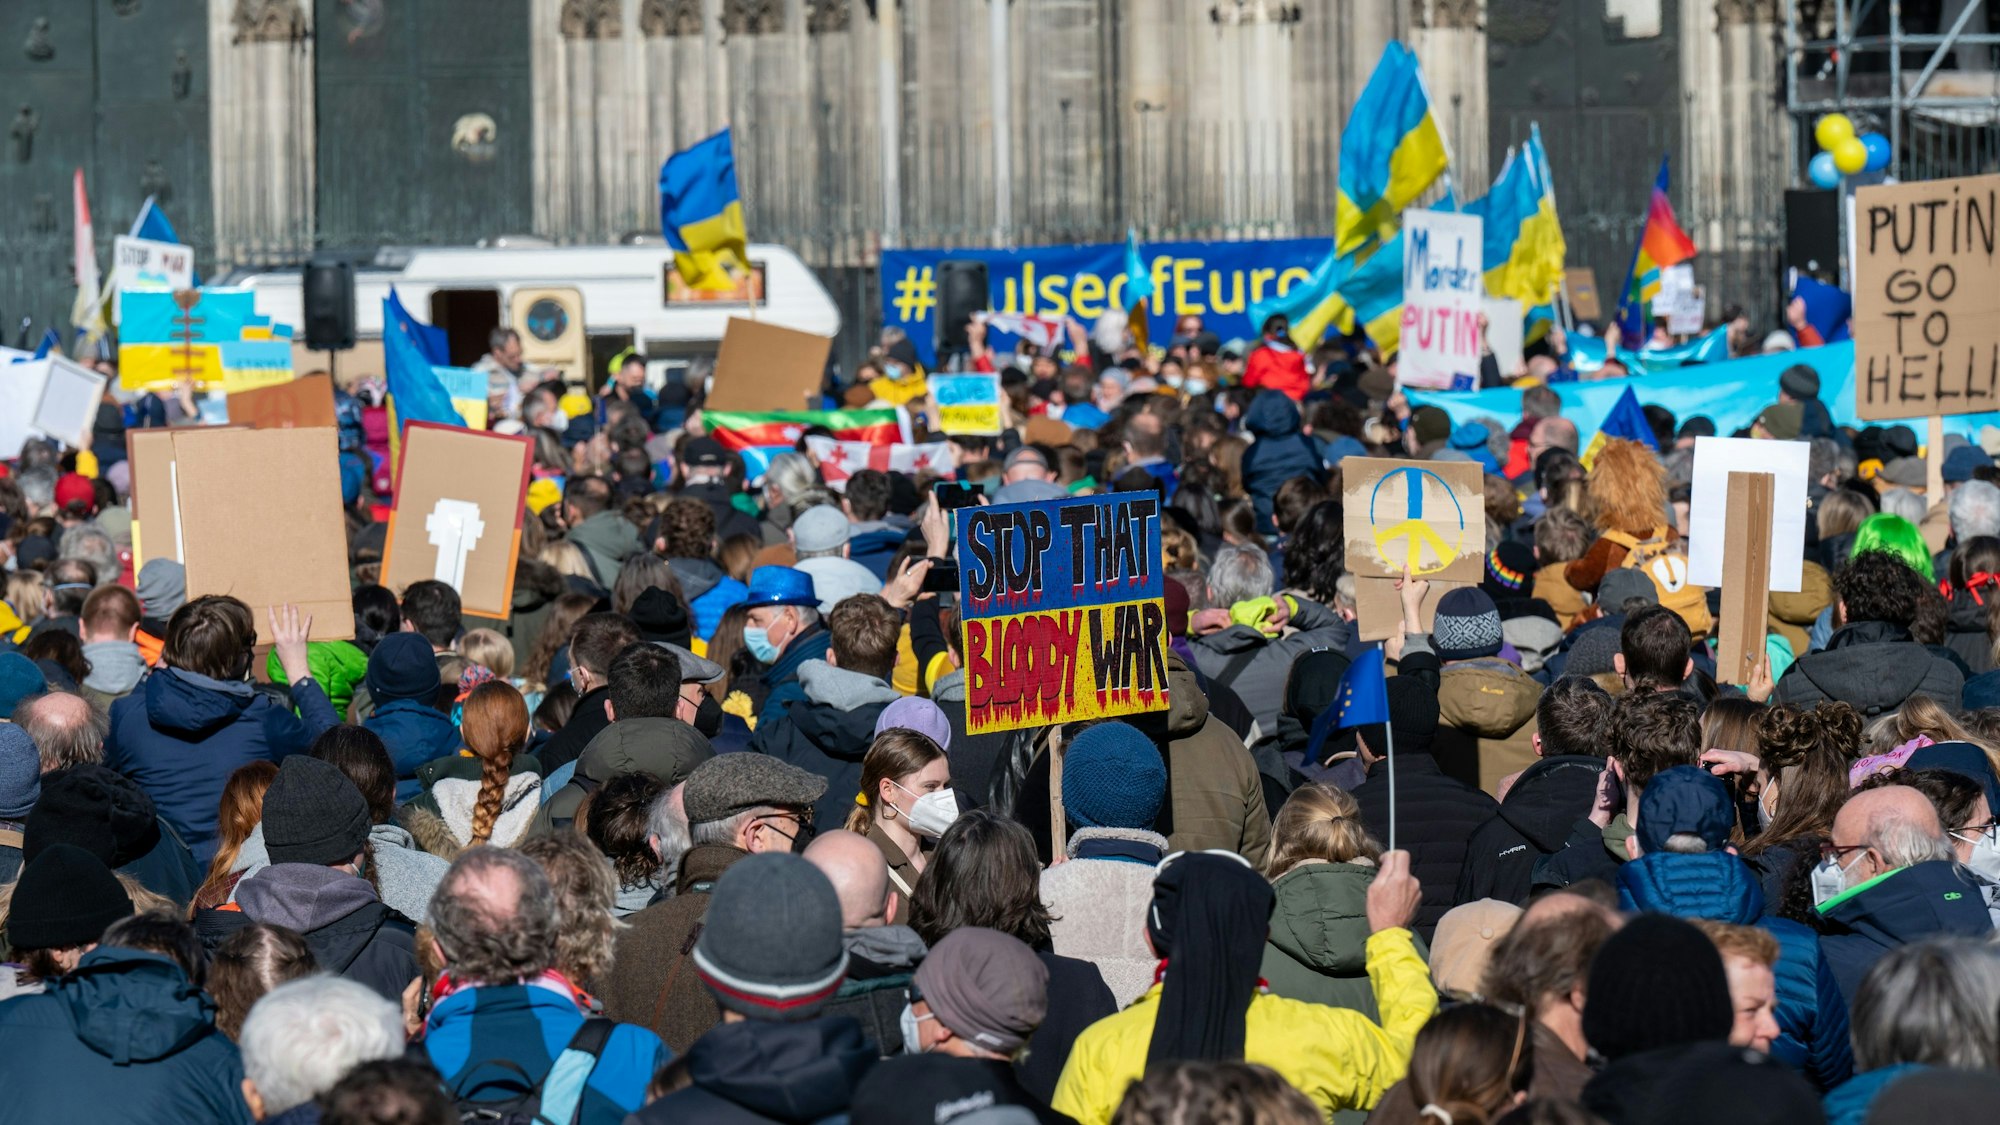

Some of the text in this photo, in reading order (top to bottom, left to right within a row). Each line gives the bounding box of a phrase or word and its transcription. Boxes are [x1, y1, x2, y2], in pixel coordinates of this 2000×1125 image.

[1885, 263, 1957, 304] GO
[1882, 310, 1950, 355] TO
[1867, 343, 1999, 406] HELL!
[968, 499, 1158, 605] STOP THAT
[967, 602, 1169, 720] BLOODY WAR
